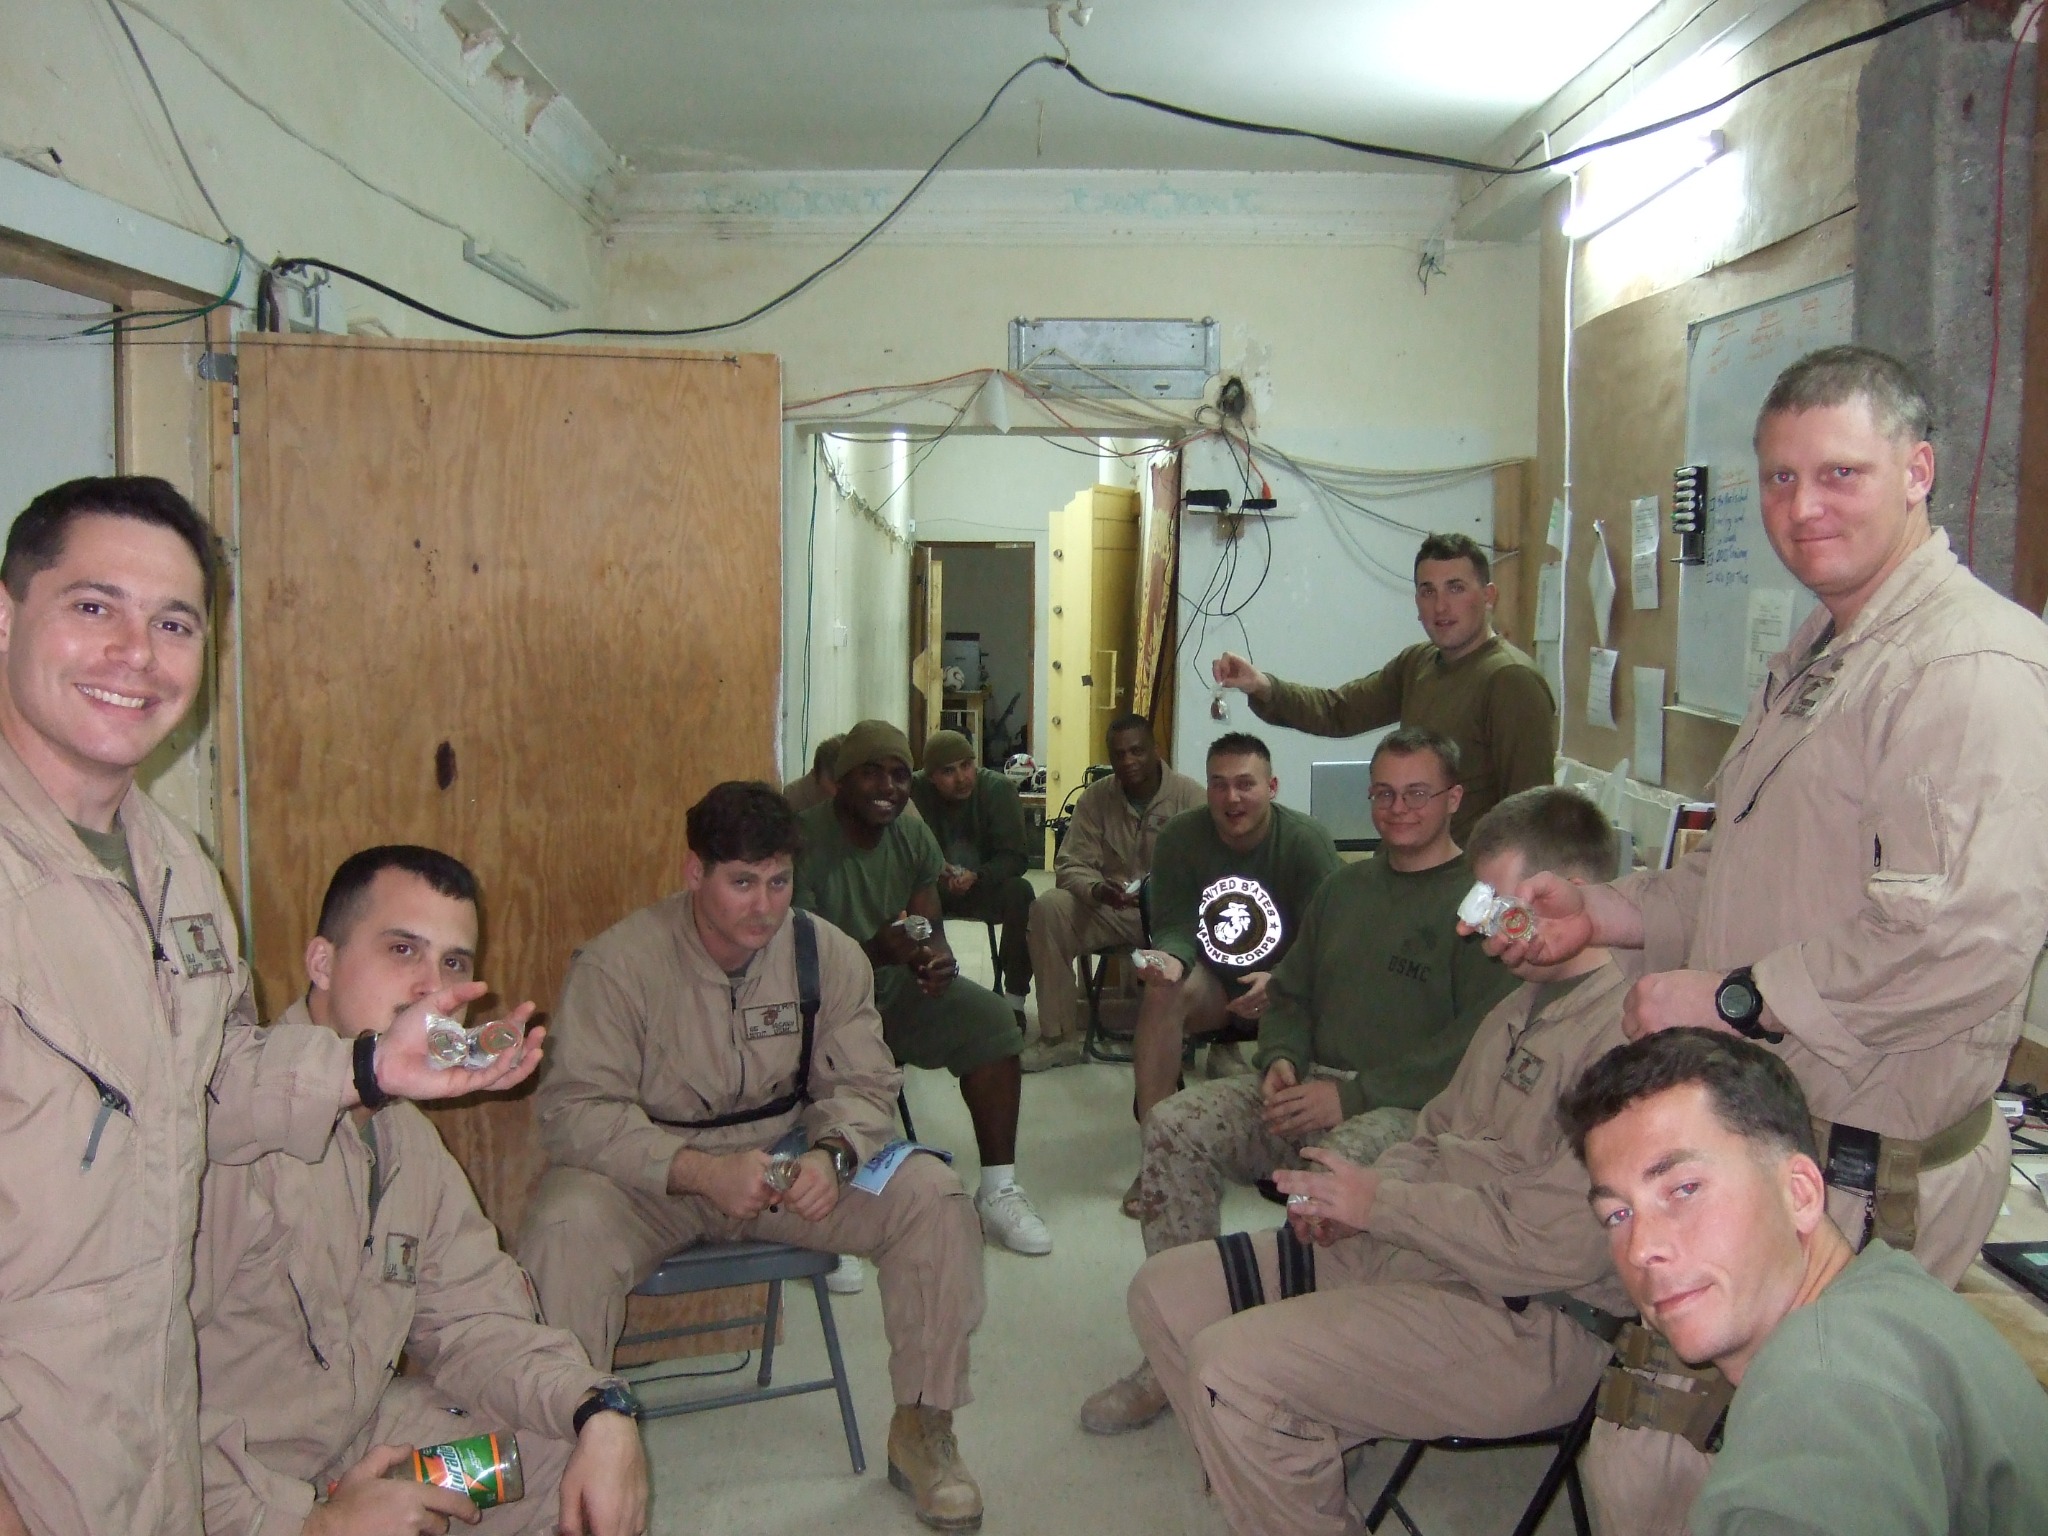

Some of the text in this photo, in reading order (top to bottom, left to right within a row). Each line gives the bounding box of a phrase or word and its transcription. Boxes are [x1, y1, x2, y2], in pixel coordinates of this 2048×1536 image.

[1235, 936, 1276, 965] CORPS
[1388, 955, 1432, 983] USMC
[438, 1445, 468, 1494] torade
